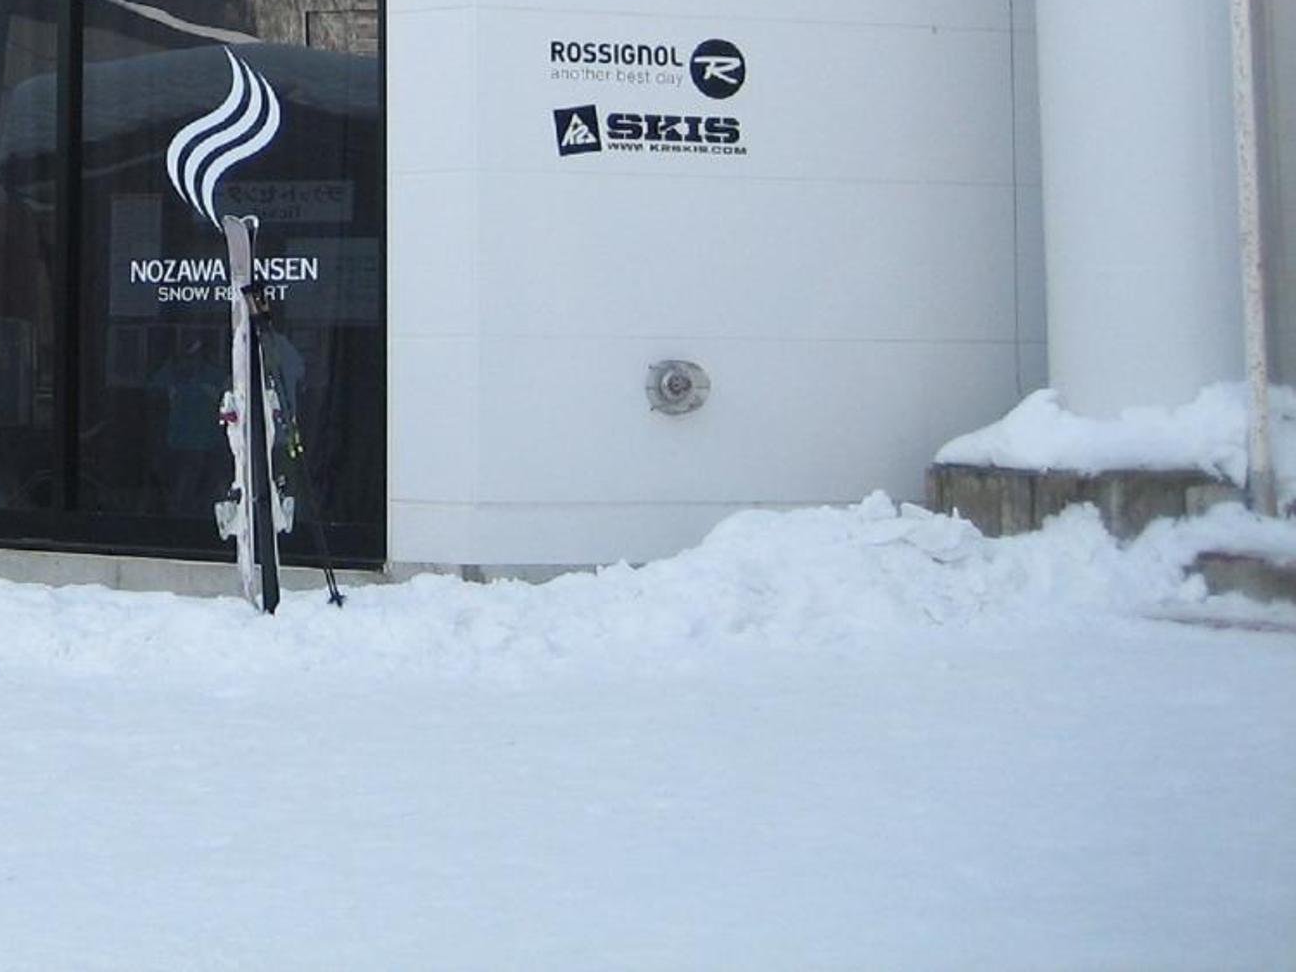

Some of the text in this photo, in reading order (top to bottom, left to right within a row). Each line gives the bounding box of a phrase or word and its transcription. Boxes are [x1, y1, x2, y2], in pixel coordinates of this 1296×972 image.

[550, 41, 684, 67] ROSSIGNOL
[551, 67, 684, 88] another best day
[607, 113, 740, 144] SKIS
[130, 258, 318, 283] NOZAWA NSEN
[158, 285, 289, 302] SNOW RERT
